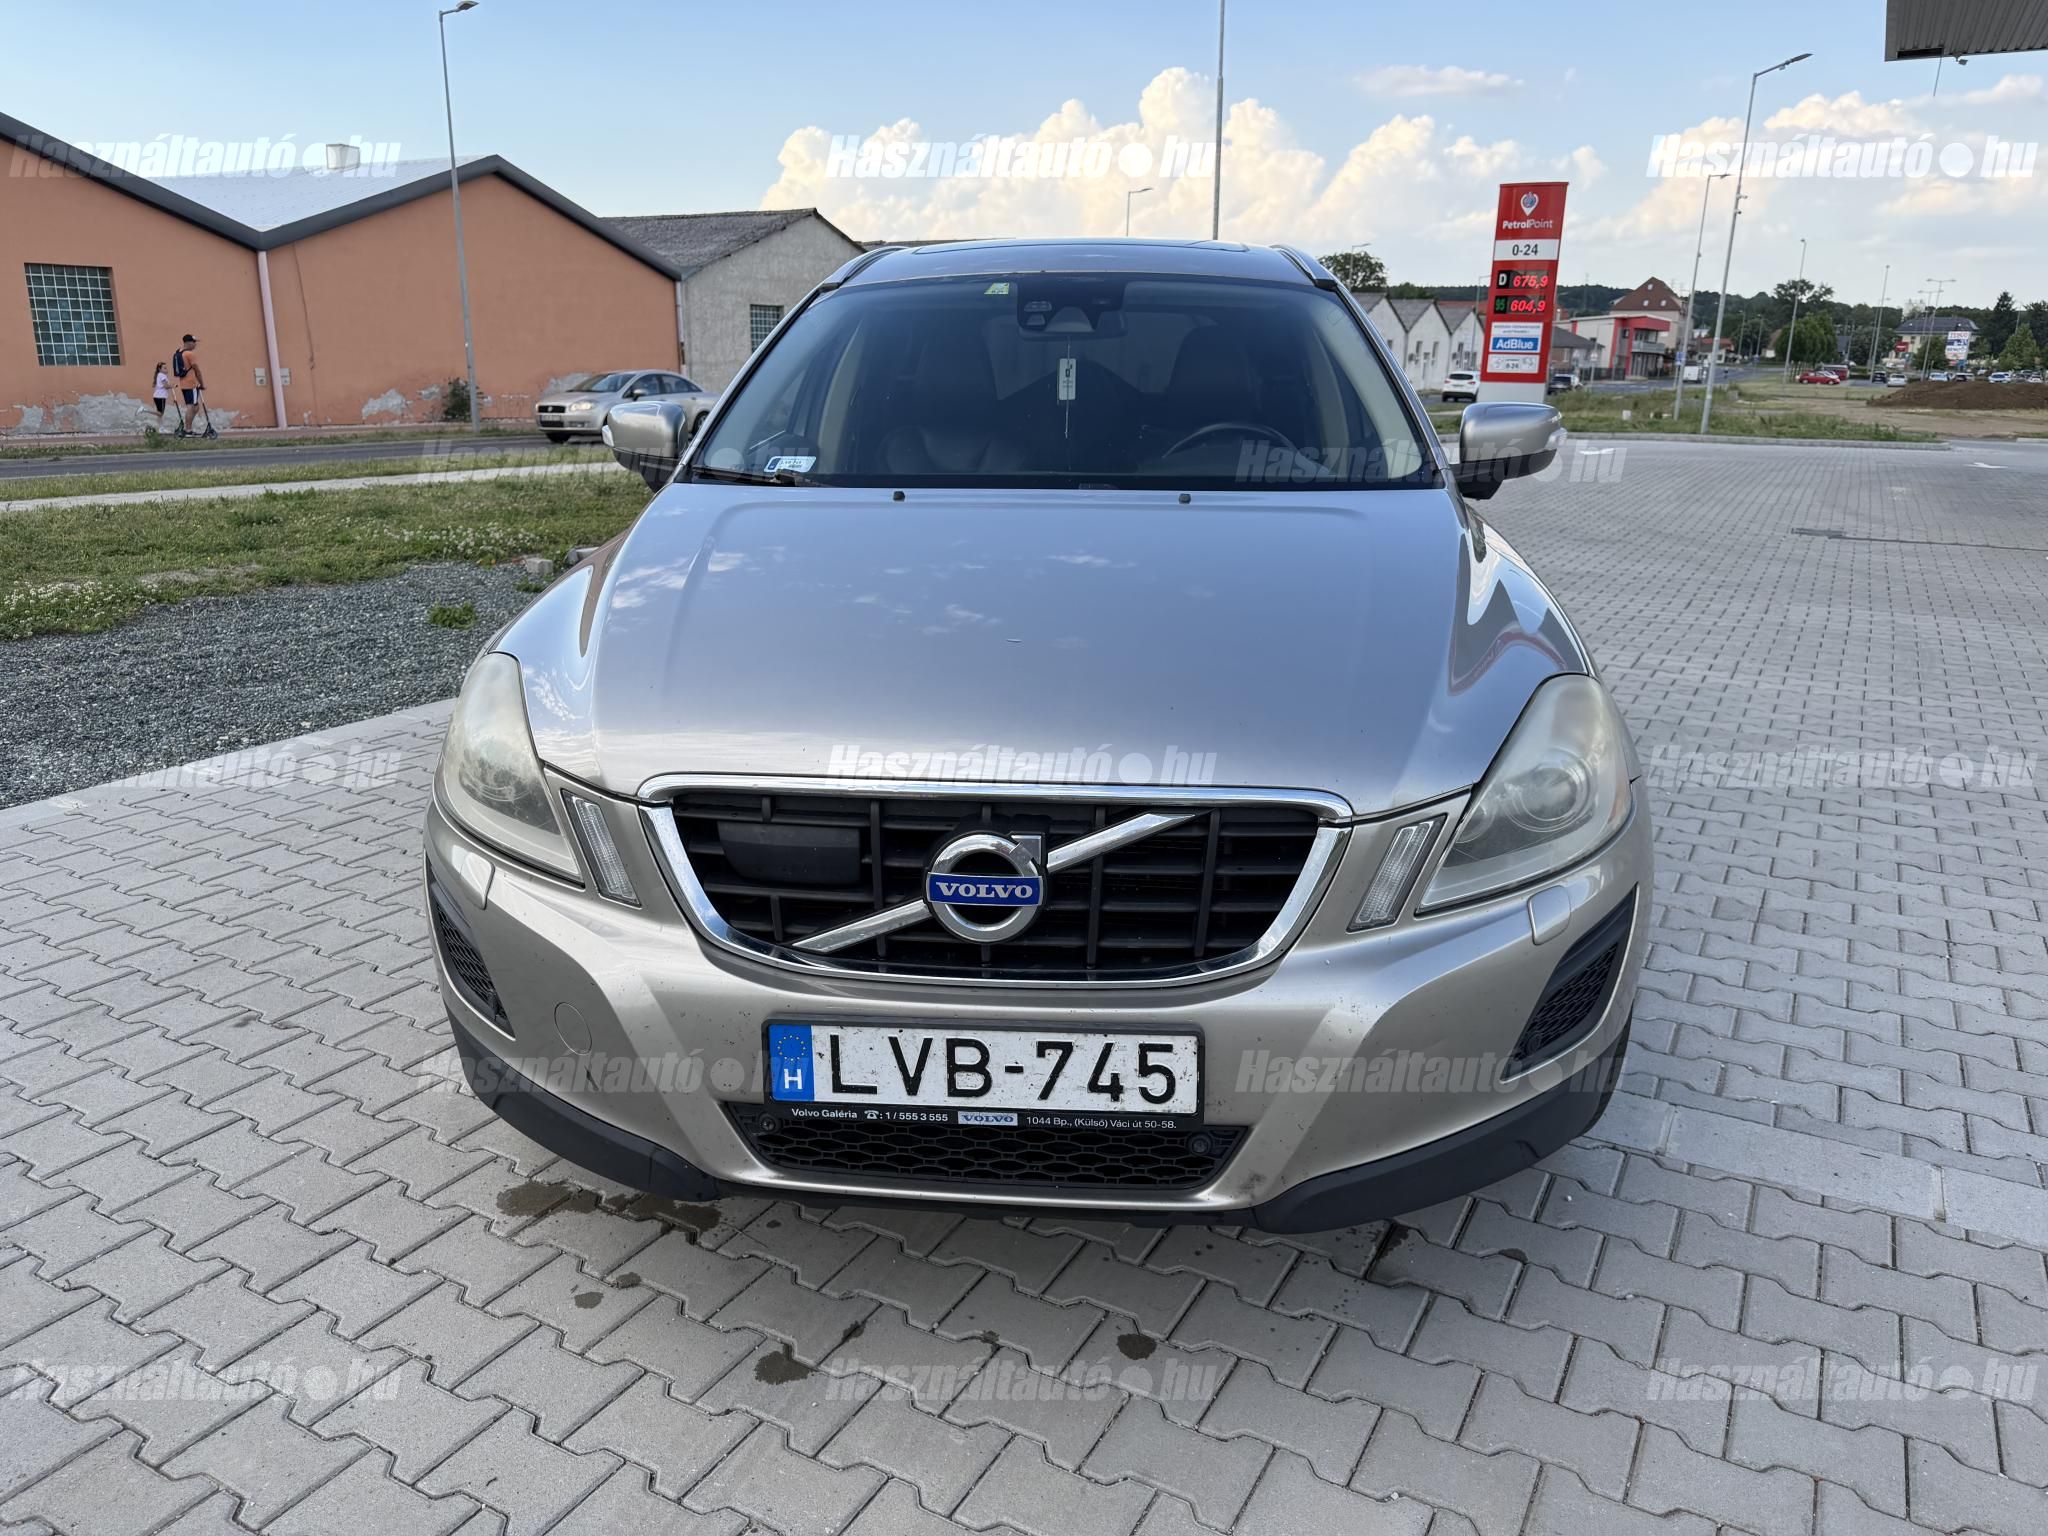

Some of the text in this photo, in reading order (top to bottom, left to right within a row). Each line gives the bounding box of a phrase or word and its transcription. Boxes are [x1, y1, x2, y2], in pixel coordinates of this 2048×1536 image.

[1502, 219, 1553, 230] PetrolPoint
[1512, 243, 1538, 256] 0-24
[1498, 274, 1548, 288] D 675,9
[1510, 300, 1546, 314] 604,9
[1496, 338, 1534, 349] AdBlue
[936, 882, 1033, 898] VOLVO
[829, 1034, 1177, 1104] LVB-745
[783, 1068, 803, 1090] H
[791, 1108, 820, 1117] Volvo
[822, 1109, 858, 1119] Galéria
[899, 1112, 918, 1120] 555
[928, 1113, 948, 1122] 555
[961, 1114, 1014, 1123] VOLVO
[1026, 1116, 1051, 1125] 1044
[1053, 1116, 1072, 1128] Bp.,
[1110, 1118, 1130, 1128] Váci
[1132, 1119, 1142, 1128] út
[1144, 1120, 1177, 1129] 50-58.
